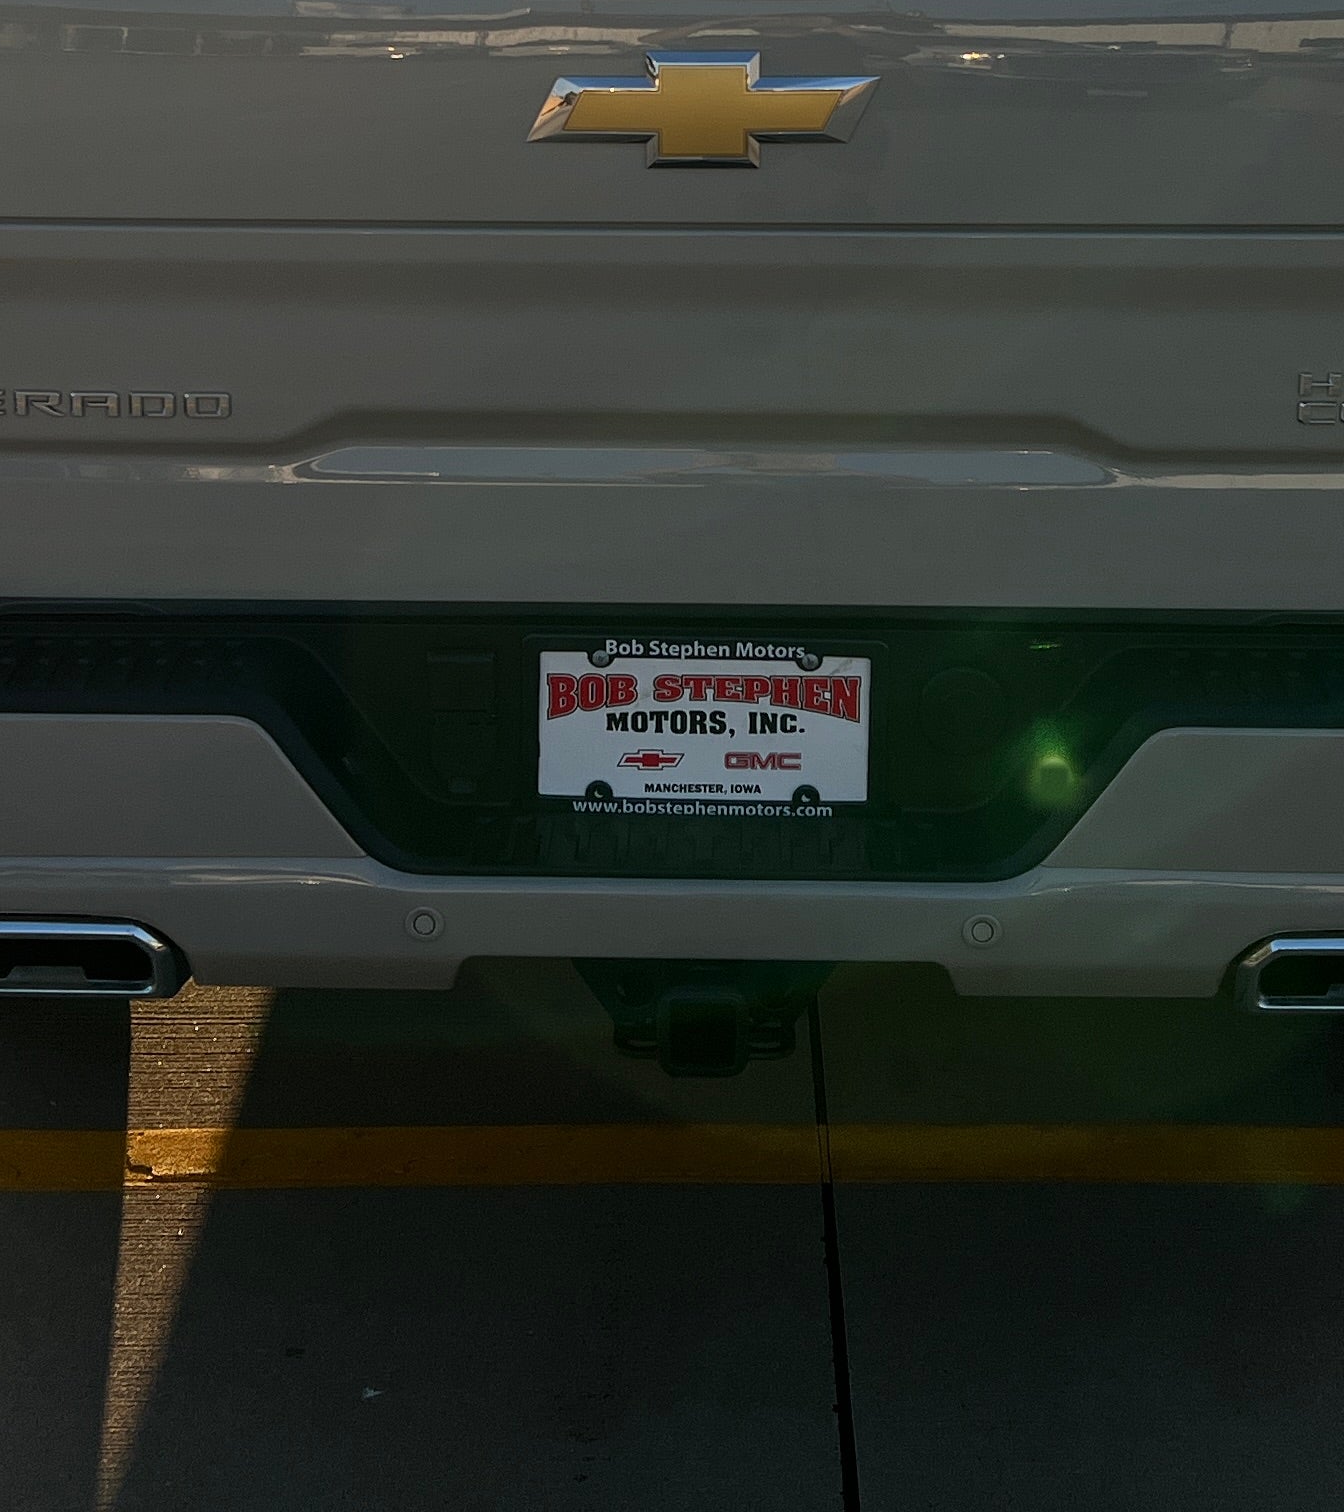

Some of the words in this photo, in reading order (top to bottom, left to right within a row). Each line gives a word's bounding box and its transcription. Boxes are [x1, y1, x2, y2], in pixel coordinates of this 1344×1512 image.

[606, 639, 644, 656] Bob
[649, 640, 729, 660] Stephen
[736, 642, 805, 659] Motors
[547, 673, 638, 720] BOB
[653, 675, 861, 723] STEPHEN
[606, 710, 735, 738] MOTORS,
[748, 712, 806, 735] INC.
[724, 752, 802, 770] GMC
[644, 783, 727, 796] MANCHESTER,
[730, 783, 762, 794] IOWA
[572, 797, 833, 818] www.bobstephenmotors.com
